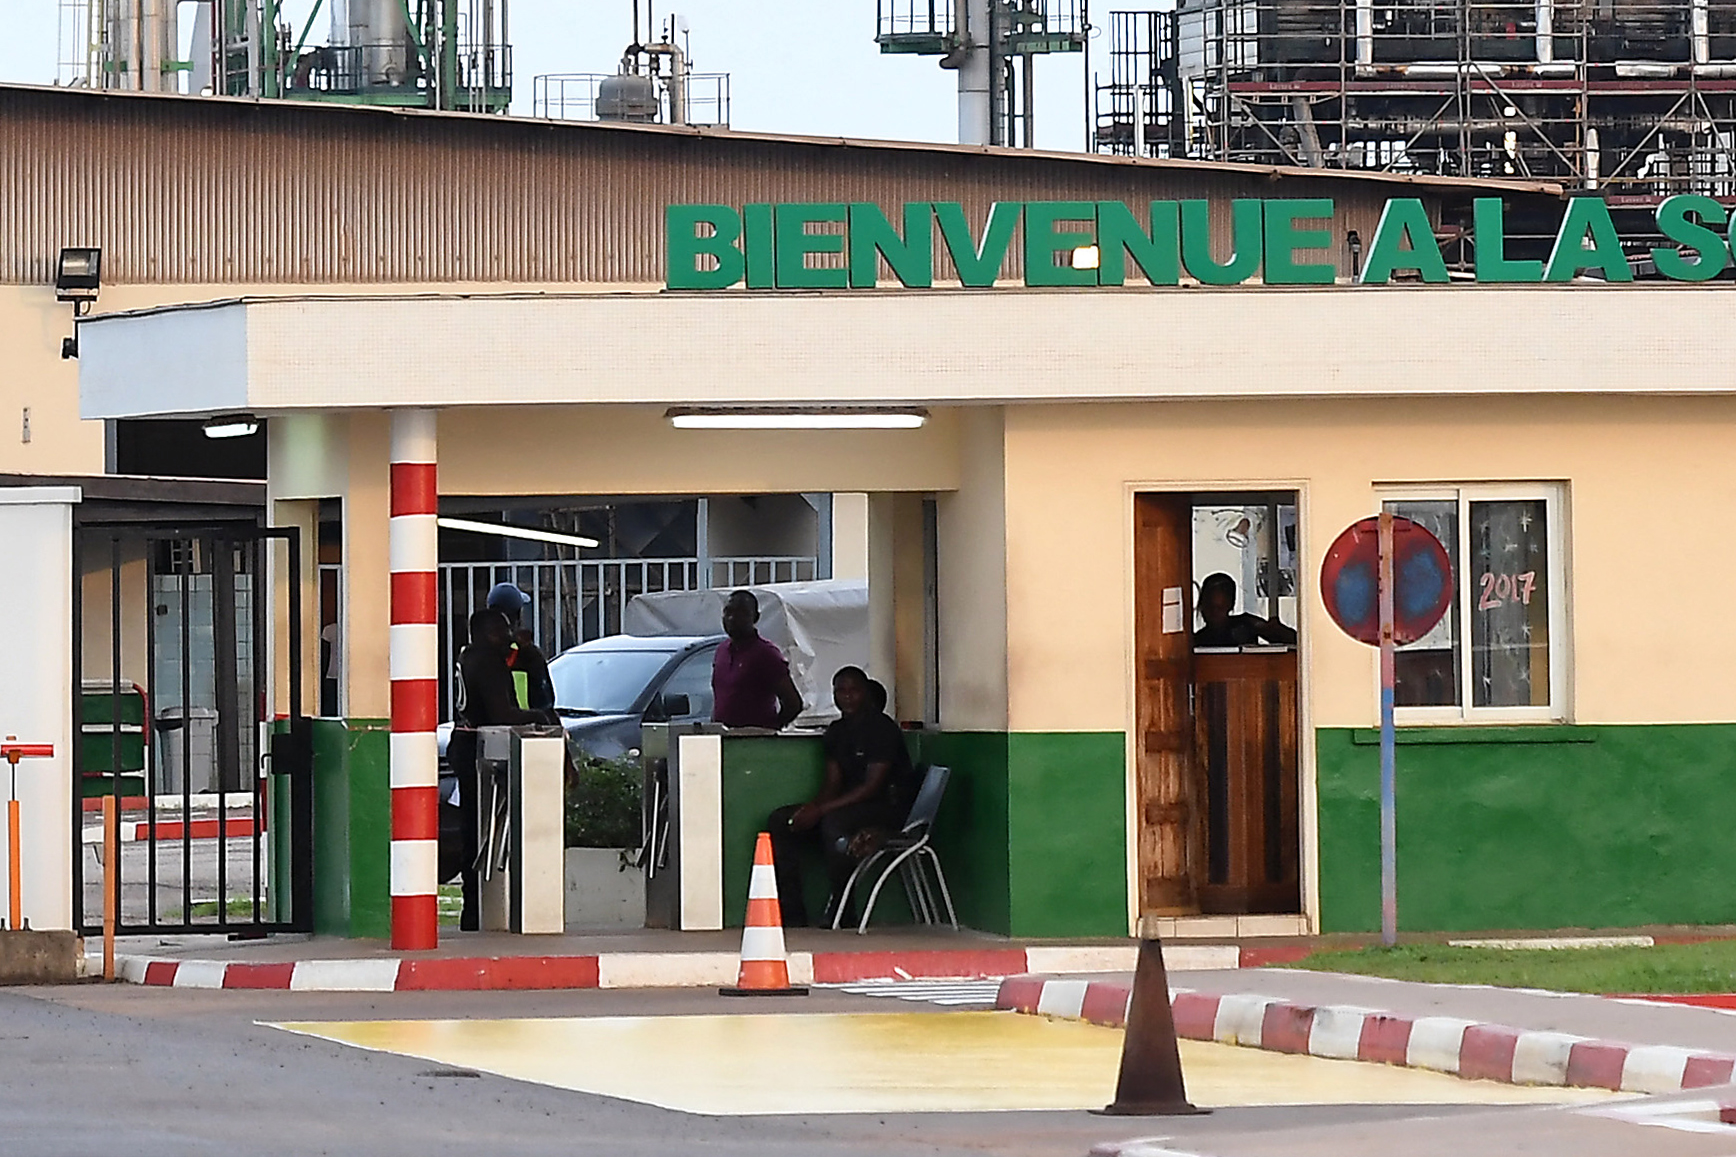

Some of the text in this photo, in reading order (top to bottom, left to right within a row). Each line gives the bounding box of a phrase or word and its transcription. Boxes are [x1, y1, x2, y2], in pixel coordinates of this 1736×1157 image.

[666, 198, 1335, 290] BIENVENUE
[1359, 196, 1452, 284] A
[1473, 196, 1634, 283] LA
[1478, 570, 1537, 612] 2017
